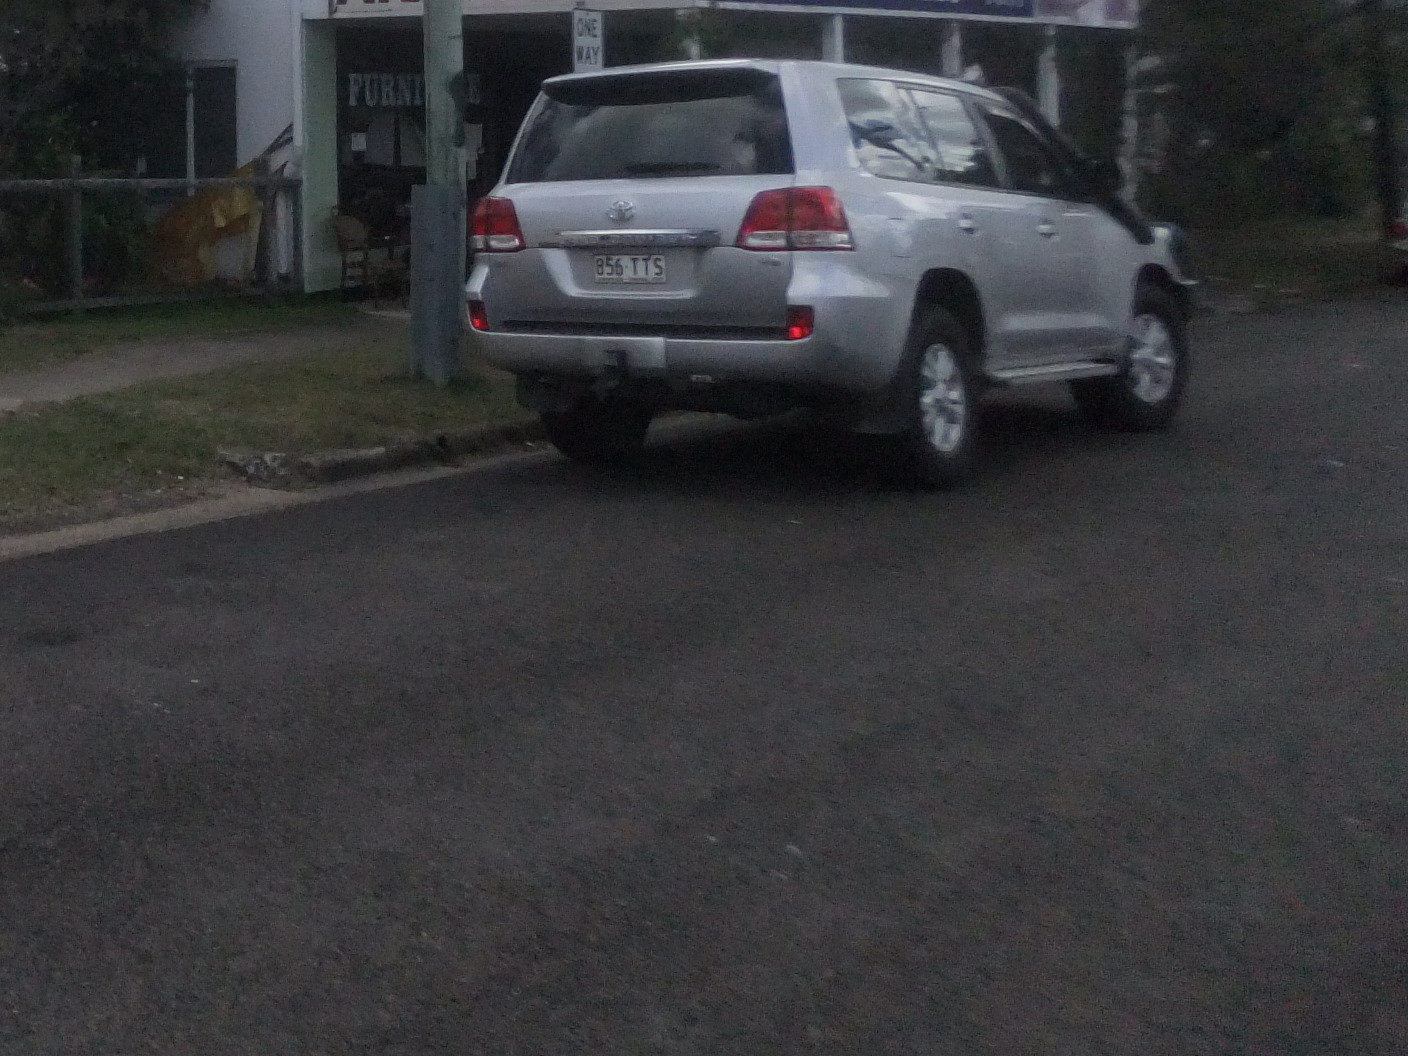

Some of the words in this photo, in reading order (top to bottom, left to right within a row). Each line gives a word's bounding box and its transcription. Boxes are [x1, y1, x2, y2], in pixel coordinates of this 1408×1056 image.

[577, 17, 598, 38] ONE
[576, 45, 600, 65] WAY
[348, 72, 481, 107] FURNIE
[596, 256, 624, 276] 856
[630, 256, 663, 276] TTS
